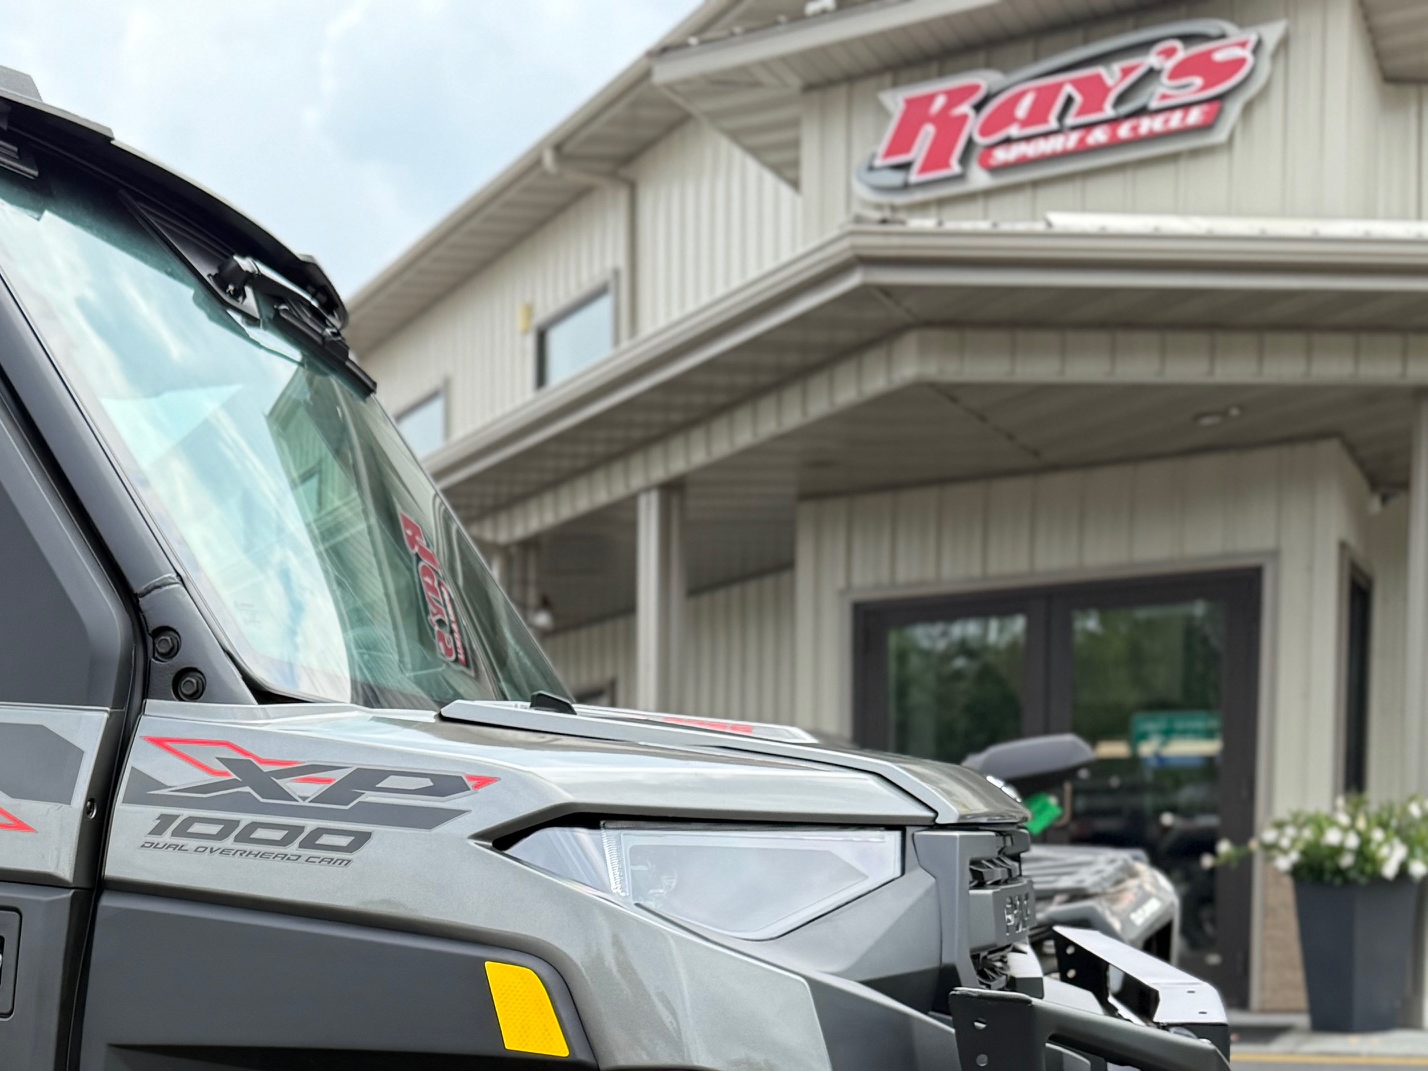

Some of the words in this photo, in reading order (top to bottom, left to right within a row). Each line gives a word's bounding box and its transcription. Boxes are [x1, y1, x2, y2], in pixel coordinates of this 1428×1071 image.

[874, 33, 1259, 183] Ray's
[988, 131, 1086, 166] SPORT
[1086, 125, 1110, 146] &
[1117, 103, 1209, 140] CYCLE
[166, 756, 475, 806] XP
[140, 841, 189, 852] DUAL
[194, 845, 302, 862] OVERHEAD
[304, 855, 353, 867] CAM
[147, 813, 373, 854] 1000
